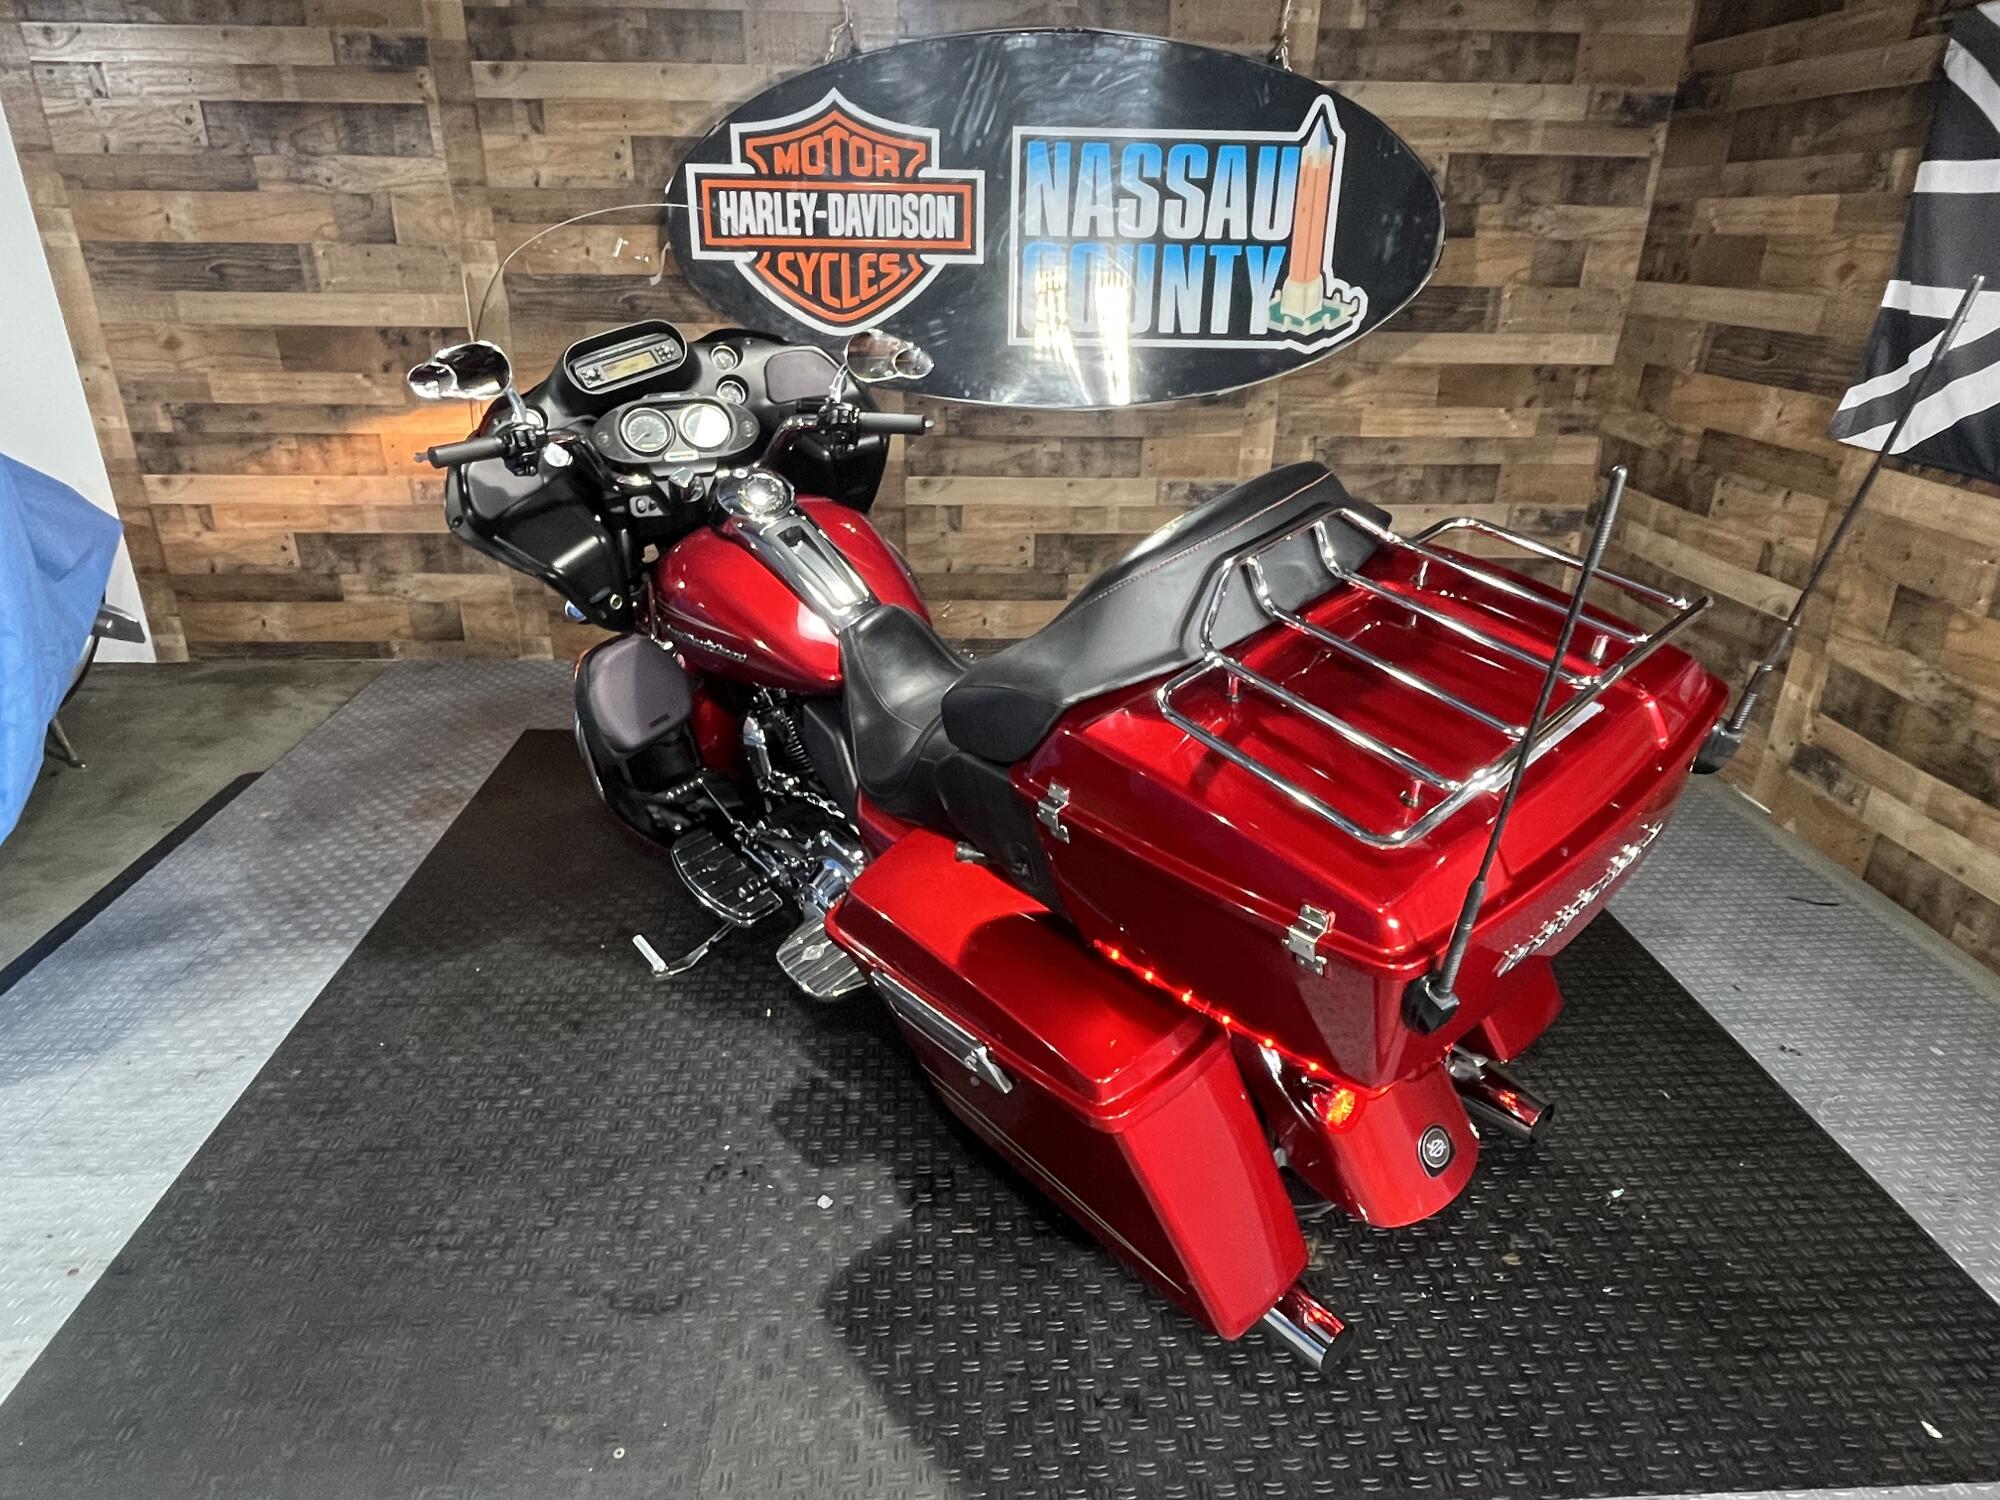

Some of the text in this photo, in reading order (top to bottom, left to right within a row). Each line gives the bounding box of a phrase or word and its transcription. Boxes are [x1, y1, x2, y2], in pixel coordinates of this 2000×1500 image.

[773, 125, 901, 178] MOTOR
[718, 190, 956, 239] HARLEY-DAVIDSON
[1024, 140, 1300, 241] NASSAU
[778, 251, 901, 309] CYCLES
